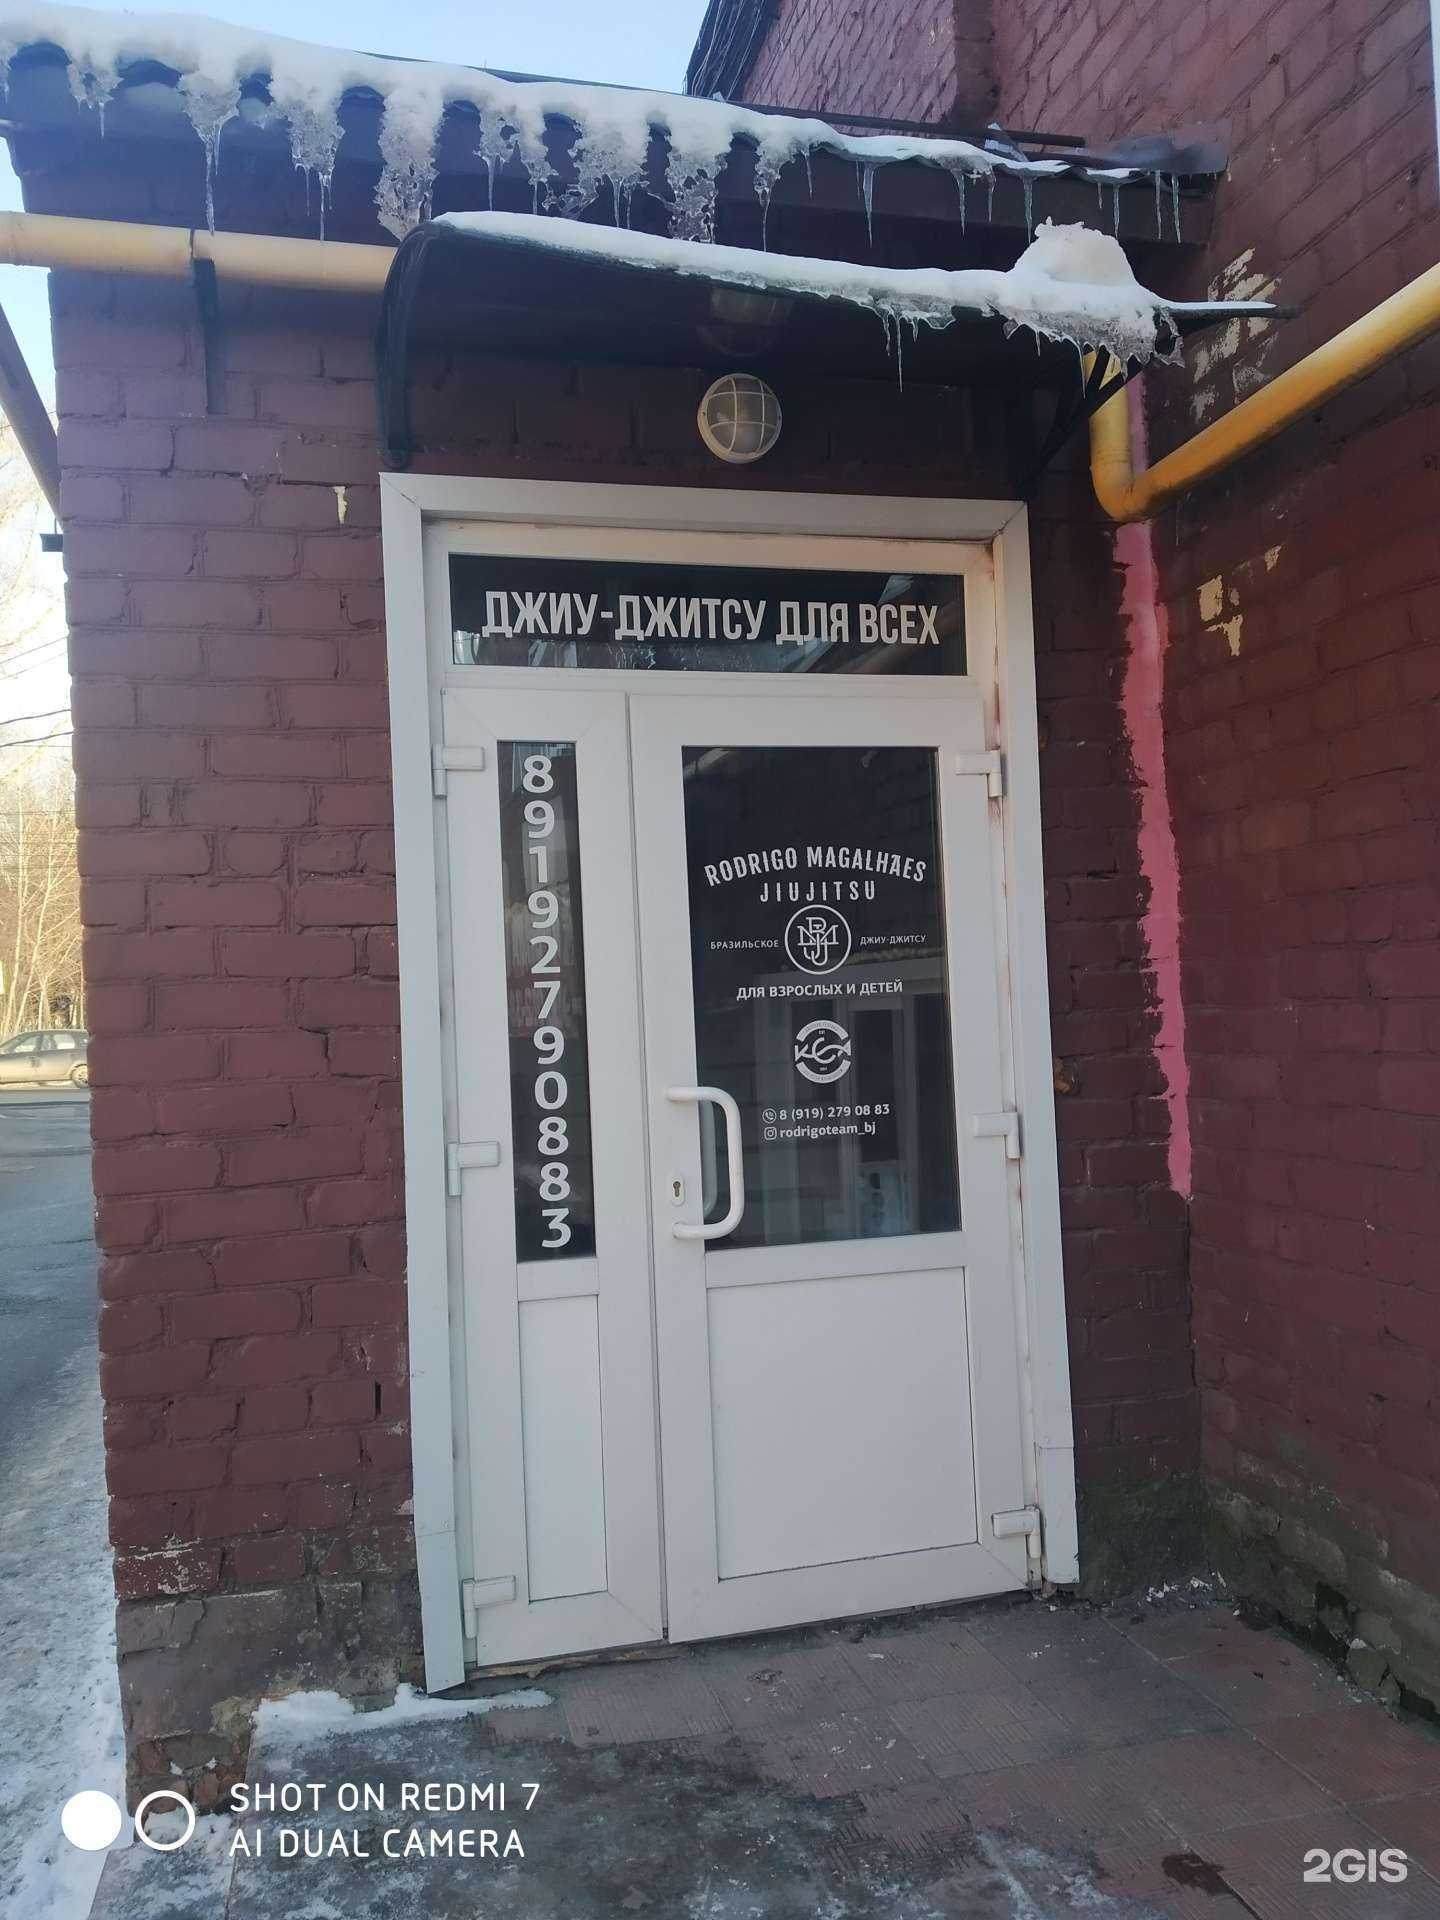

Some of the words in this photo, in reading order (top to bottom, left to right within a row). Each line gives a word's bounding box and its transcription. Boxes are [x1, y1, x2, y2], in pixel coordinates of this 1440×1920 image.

[481, 590, 766, 641] ДЖИУ-ДЖИТСУ
[776, 601, 850, 645] ДЛЯ
[858, 603, 940, 645] ВСЕХ
[704, 848, 797, 886] RODRIGO
[759, 881, 876, 902] JIUJITSU
[710, 939, 779, 950] БРАЗИЛЬСКОЕ
[859, 935, 927, 946] ДЖИУ-ДЖИТСУ
[736, 986, 765, 1001] ДЛЯ
[769, 983, 842, 998] ВЗРОСЛЫХ
[846, 983, 856, 995] И
[859, 979, 903, 995] ДЕТЕЙ
[522, 754, 573, 1249] 89192790883
[779, 1110, 788, 1120] 8
[791, 1108, 824, 1121] (919)
[827, 1106, 851, 1118] 279
[854, 1104, 871, 1116] 08
[874, 1103, 890, 1115] 83
[780, 1122, 875, 1138] rodrigoteam_bj
